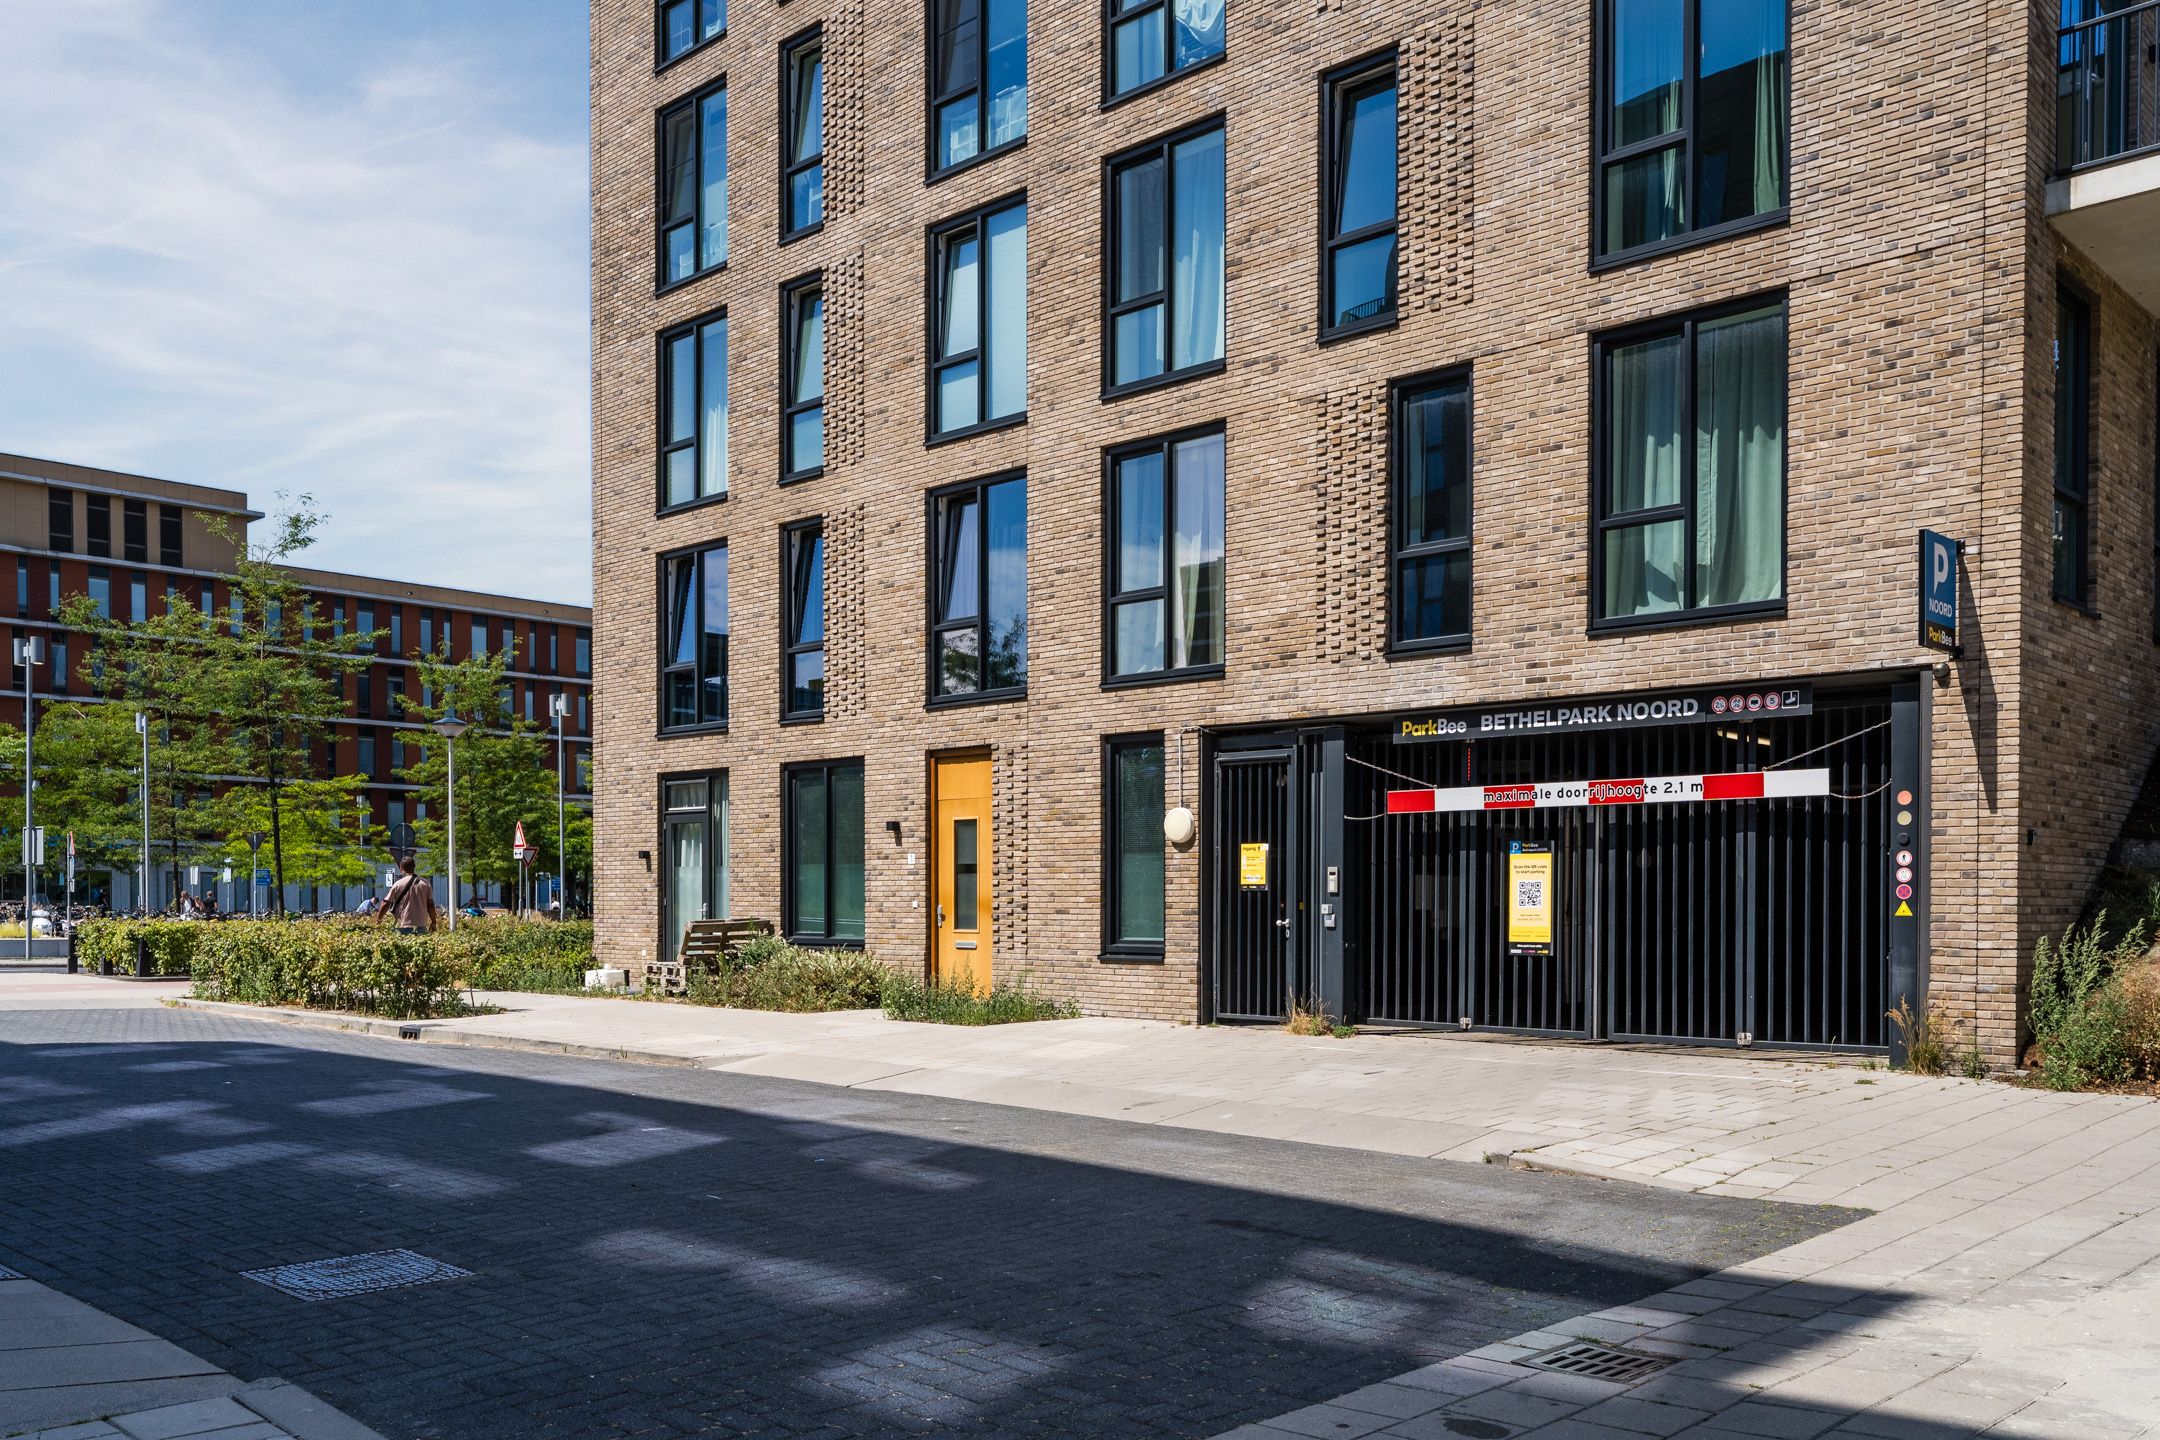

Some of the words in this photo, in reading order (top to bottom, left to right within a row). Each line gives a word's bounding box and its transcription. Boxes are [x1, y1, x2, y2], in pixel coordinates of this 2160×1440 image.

[1933, 542, 1949, 595] P
[1929, 598, 1953, 618] NOORD
[1929, 627, 1952, 647] ParkBee
[1402, 718, 1467, 737] ParkBee
[1480, 706, 1612, 732] BETHELPARK
[1617, 698, 1698, 721] NOORD
[1484, 786, 1551, 803] maximale
[1557, 782, 1658, 802] doorrijhoogte
[1690, 783, 1703, 793] m
